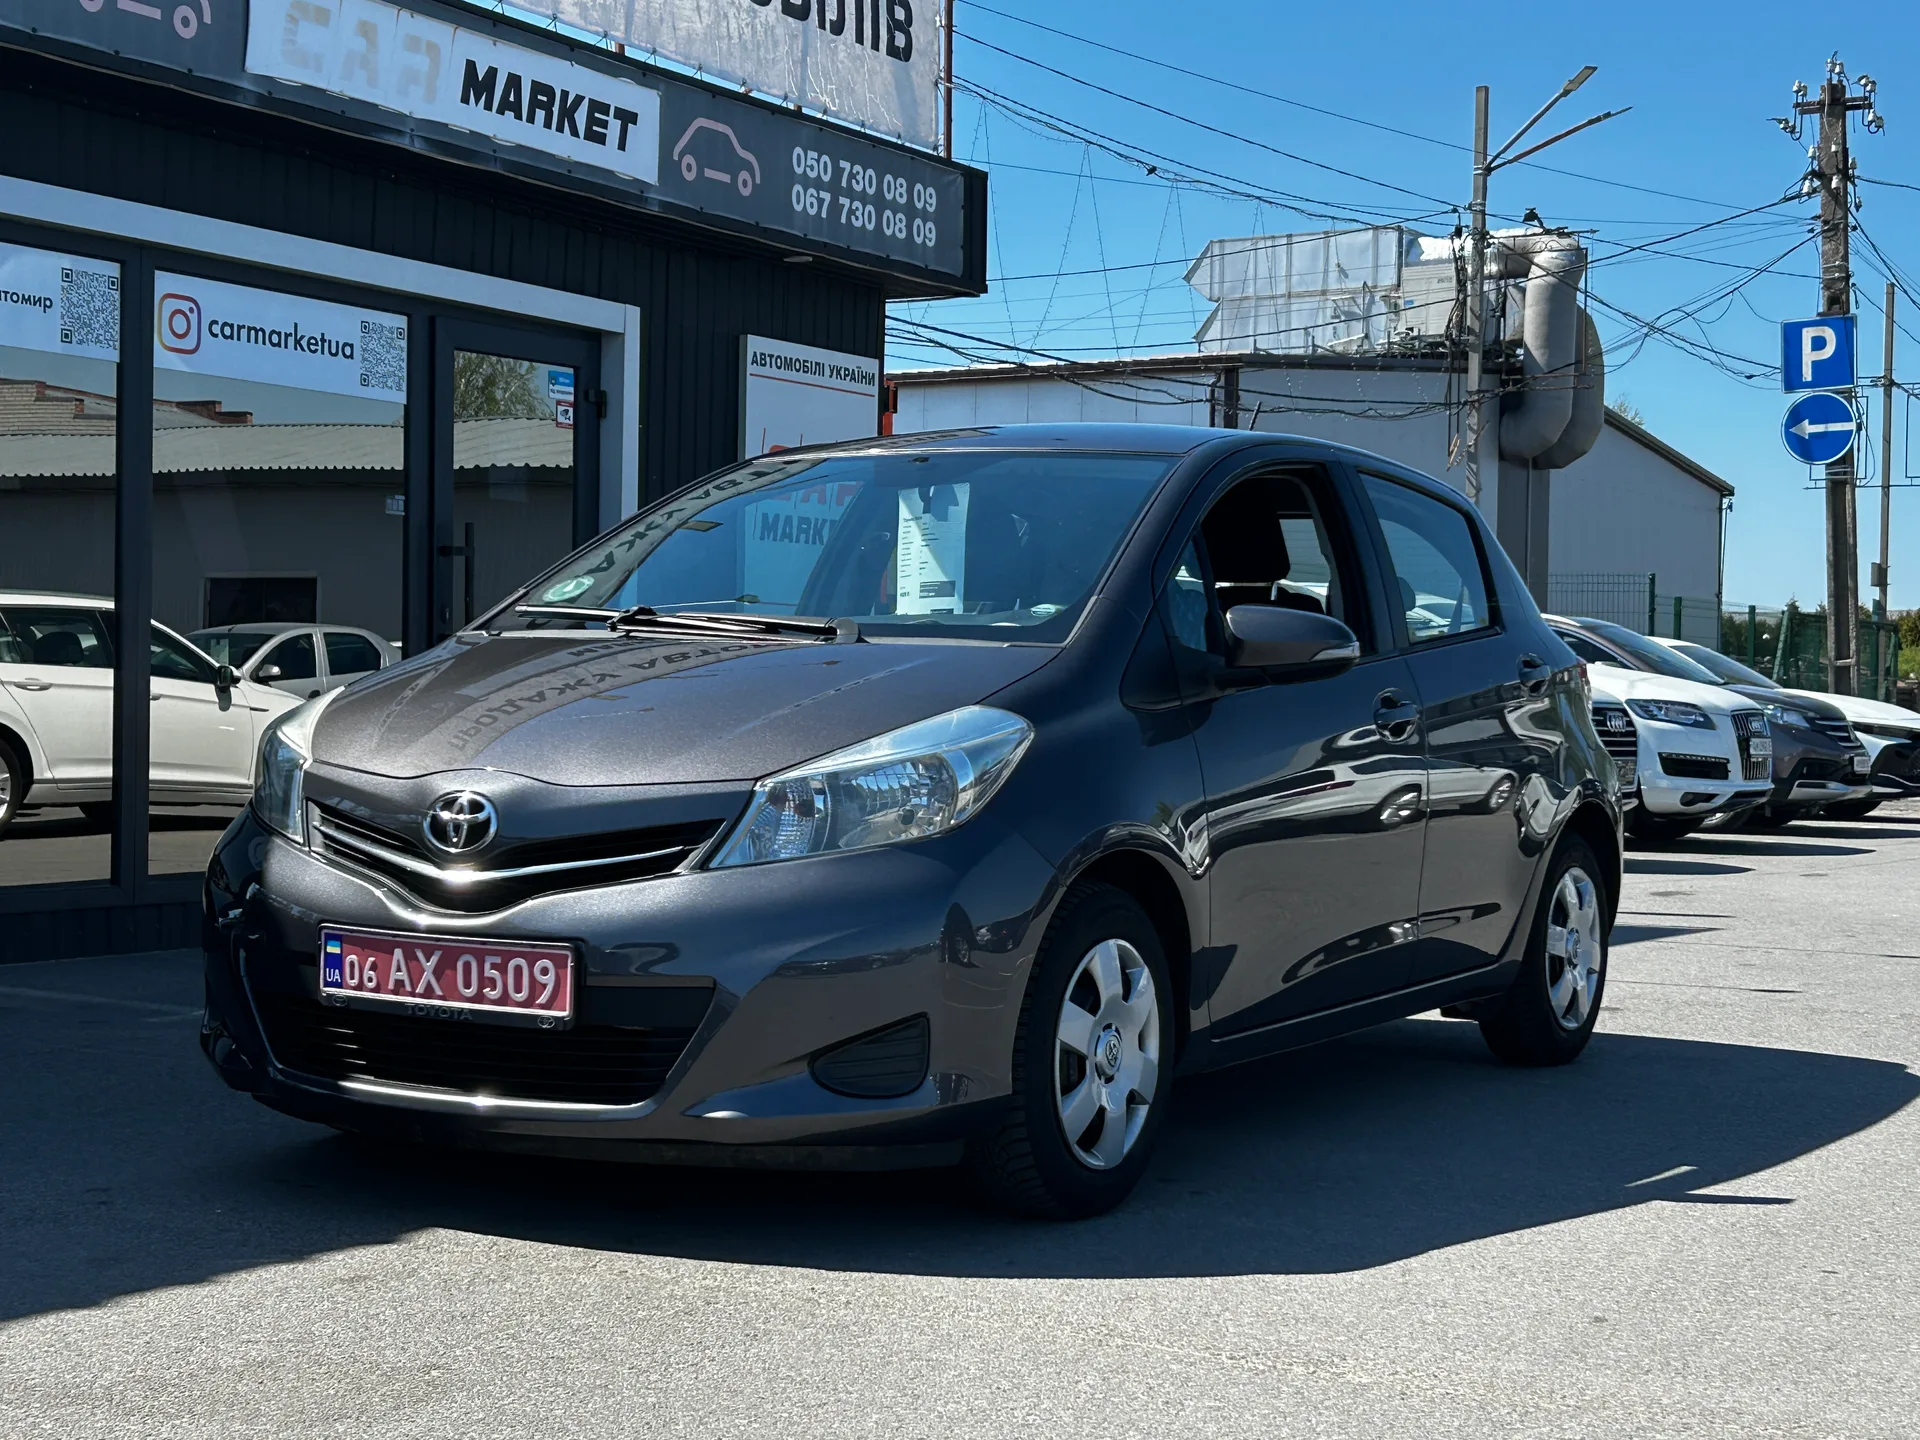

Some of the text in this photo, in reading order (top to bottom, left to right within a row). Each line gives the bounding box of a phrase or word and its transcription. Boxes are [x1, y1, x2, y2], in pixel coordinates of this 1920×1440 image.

[460, 58, 639, 152] MARKET
[792, 146, 937, 212] 050 730 08 09
[791, 184, 936, 247] 067 730 08 09
[0, 290, 53, 313] томир
[208, 318, 355, 360] carmarketua
[1802, 325, 1837, 382] P
[751, 351, 875, 387] АВТОМОБІЛІ УКРАЇНИ
[325, 968, 342, 983] UA
[345, 948, 557, 1005] 06 AX 0509
[405, 1003, 473, 1021] TOYOTA
